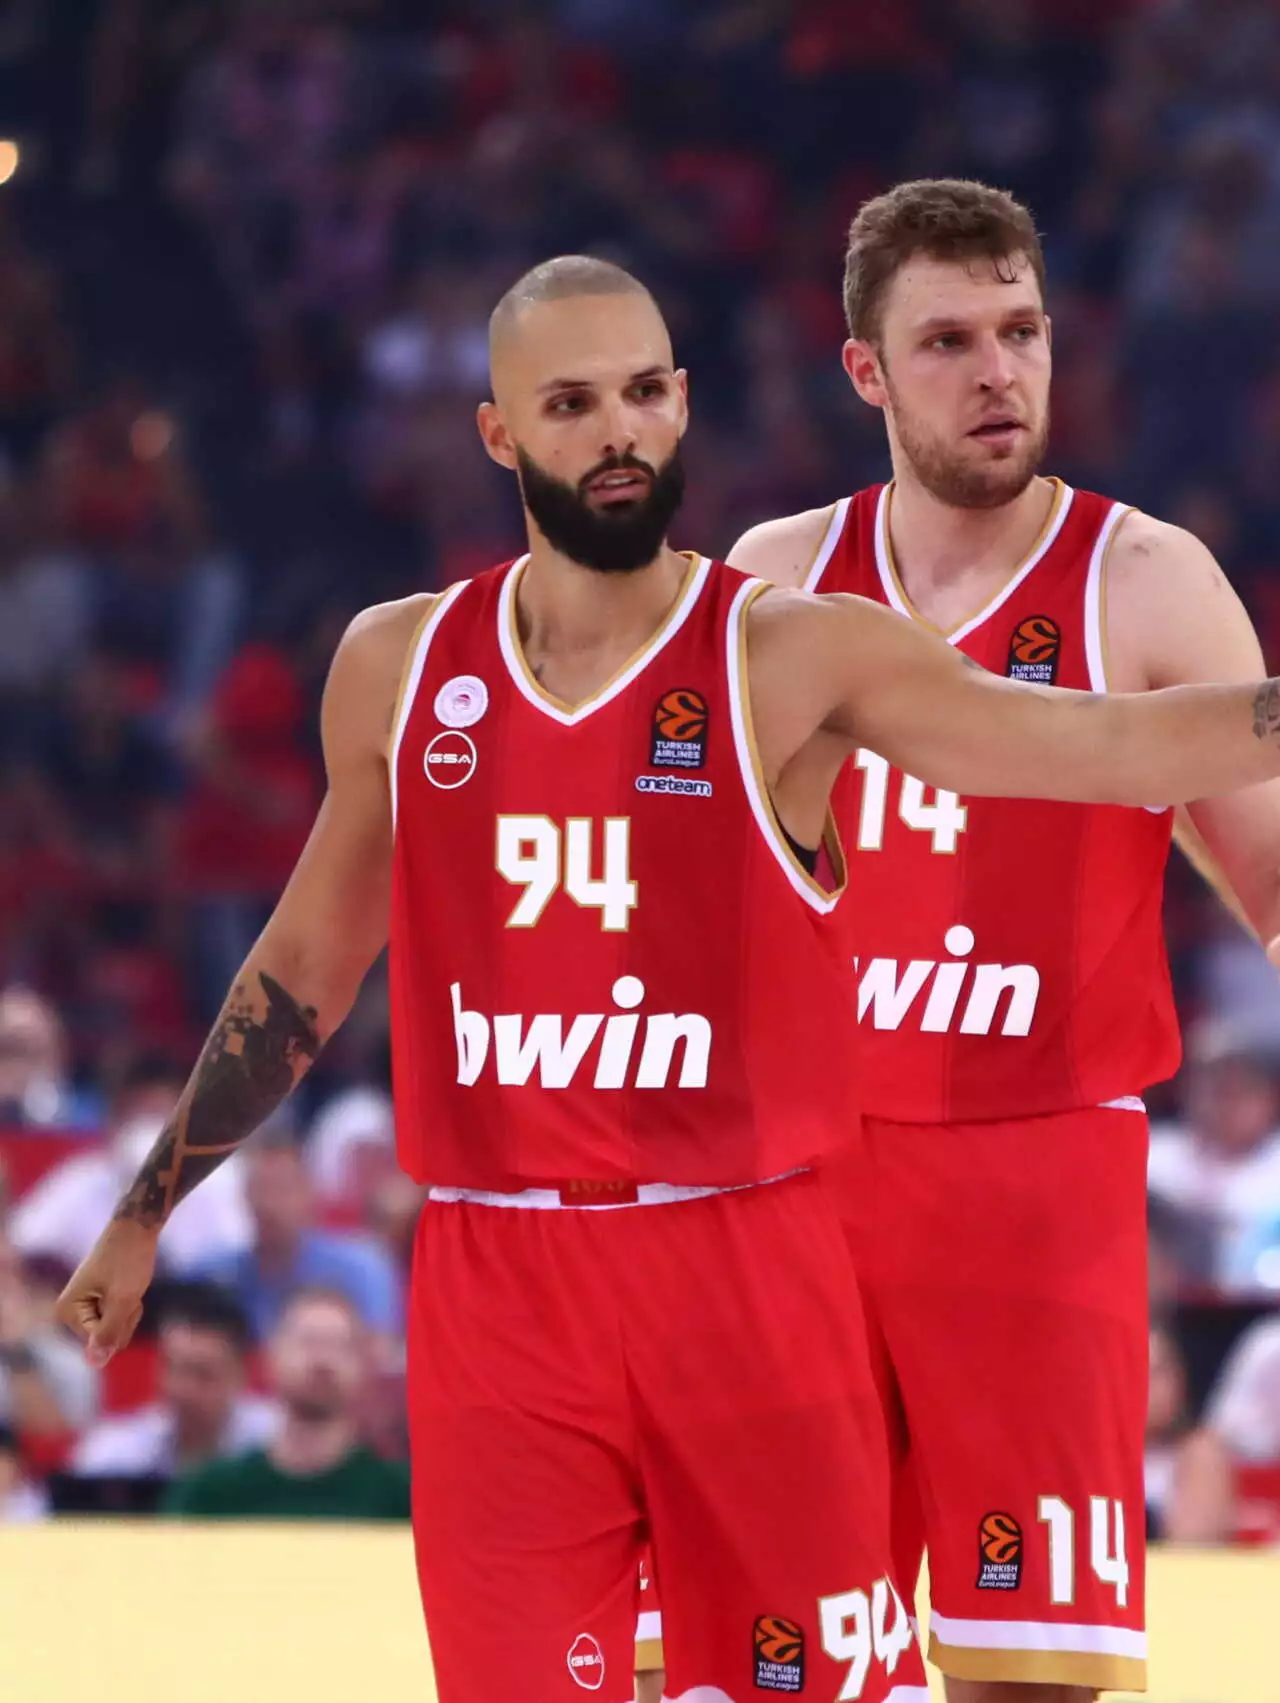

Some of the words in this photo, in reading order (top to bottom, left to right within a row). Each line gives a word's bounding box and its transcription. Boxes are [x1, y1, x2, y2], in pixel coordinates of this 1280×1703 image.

[1011, 664, 1053, 673] TURKISH
[1010, 672, 1052, 681] AIRLINES
[656, 740, 701, 751] TURKISH
[428, 752, 472, 764] GSA
[655, 750, 700, 760] AIRLINES
[637, 776, 711, 795] oneteam
[855, 748, 967, 853] 14
[495, 814, 638, 931] 94
[853, 925, 1040, 1037] win
[450, 975, 712, 1088] bwin
[1038, 1494, 1129, 1608] 14
[983, 1564, 1018, 1573] TURKISH
[982, 1572, 1017, 1581] AIRLINES
[817, 1574, 913, 1703] 94
[758, 1661, 800, 1674] TURKISH
[758, 1670, 800, 1682] AIRLINES
